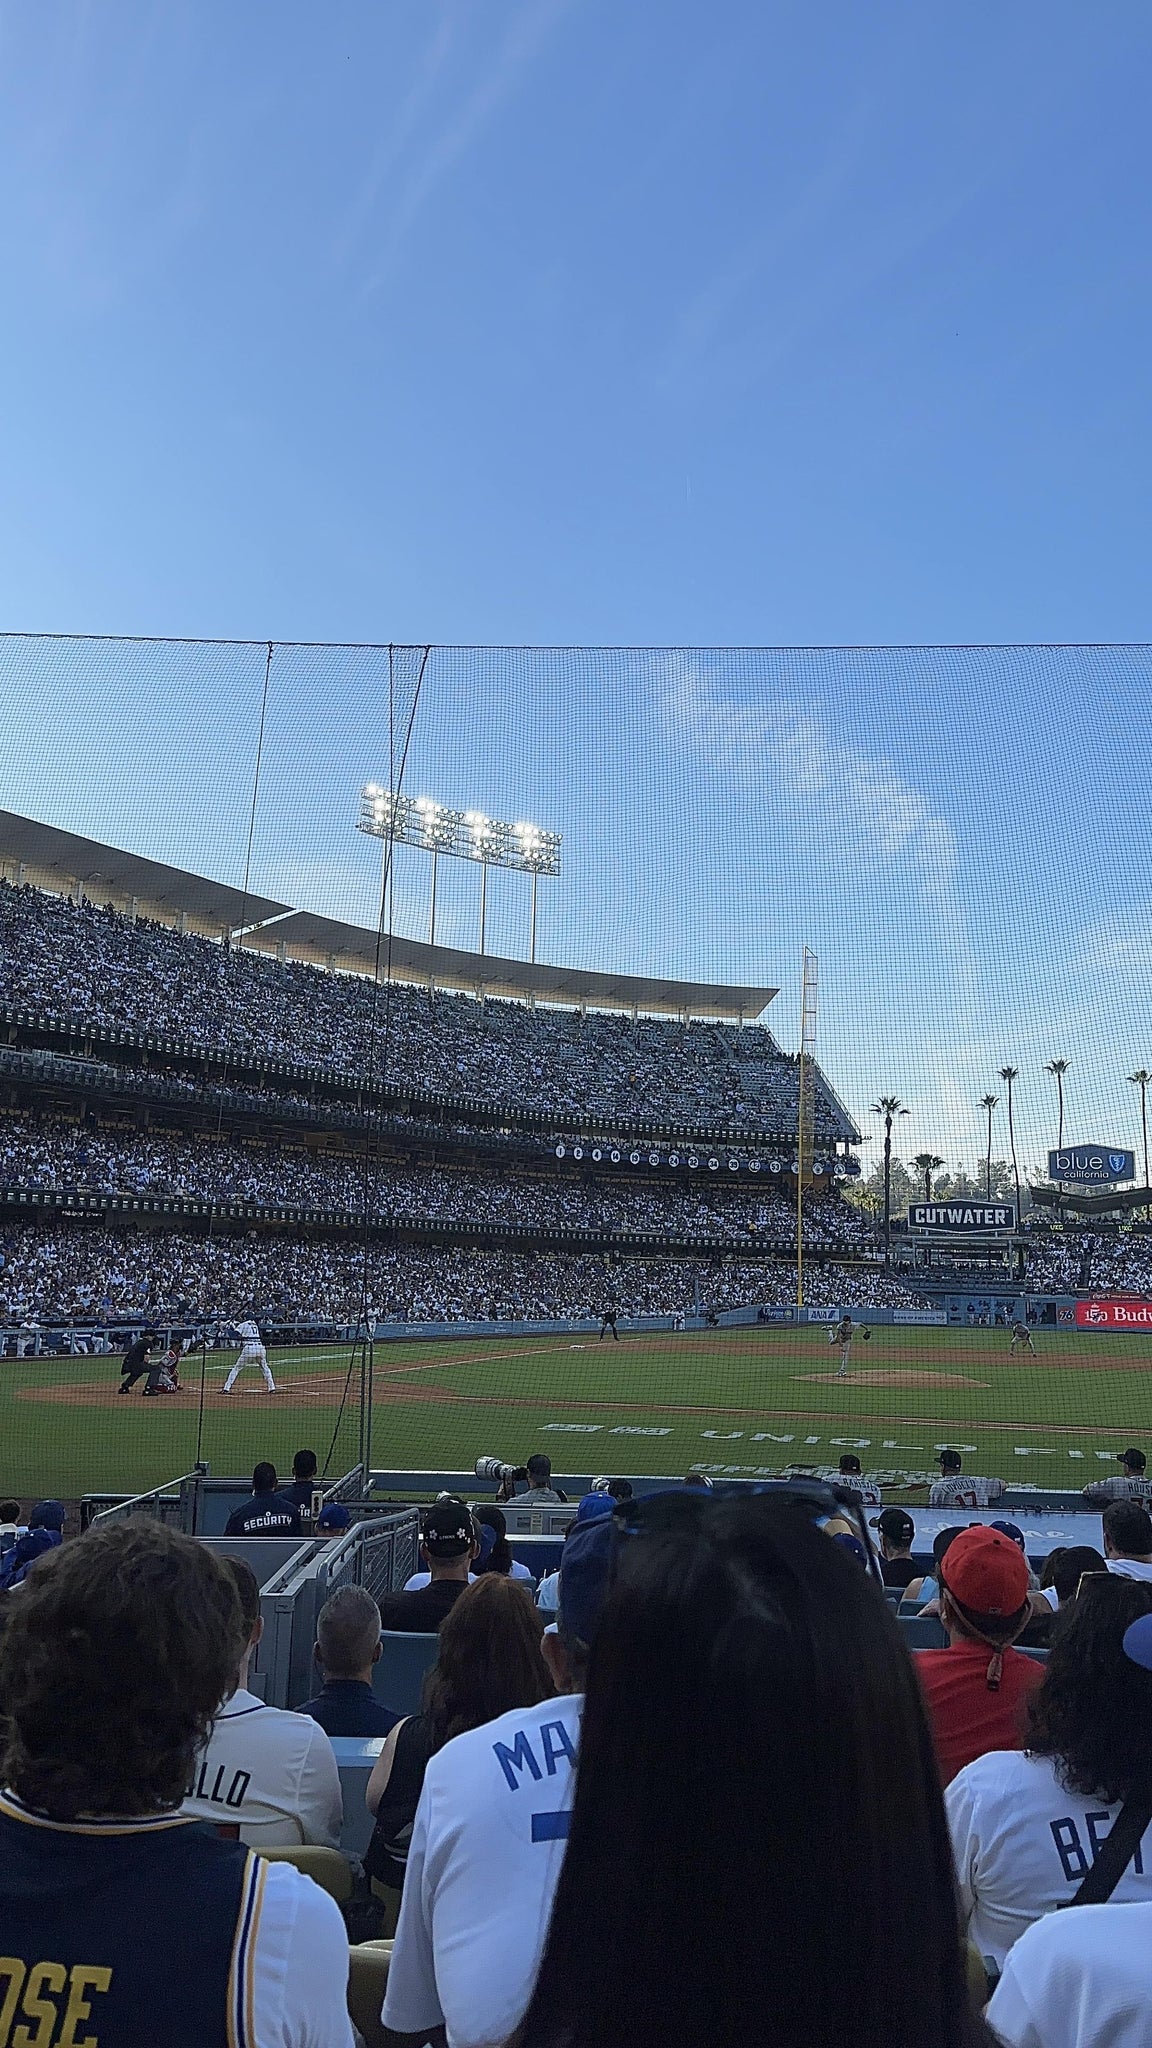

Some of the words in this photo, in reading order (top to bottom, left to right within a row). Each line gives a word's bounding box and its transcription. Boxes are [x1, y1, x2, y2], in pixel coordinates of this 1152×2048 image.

[649, 1155, 659, 1164] 20
[669, 1157, 679, 1166] 24
[688, 1158, 698, 1167] 32
[708, 1160, 719, 1169] 34
[750, 1161, 759, 1171] 42
[770, 1162, 781, 1172] 53
[1056, 1152, 1103, 1170] blue
[1063, 1170, 1109, 1179] california
[915, 1208, 1006, 1225] CUTWATER
[811, 1310, 828, 1319] ANA
[1060, 1310, 1074, 1321] 76
[700, 1430, 978, 1452] UNIQLO
[1127, 1482, 1152, 1494] HOUS
[955, 1491, 977, 1506] 17
[243, 1515, 292, 1531] SECURITY
[185, 1761, 251, 1808] LLO
